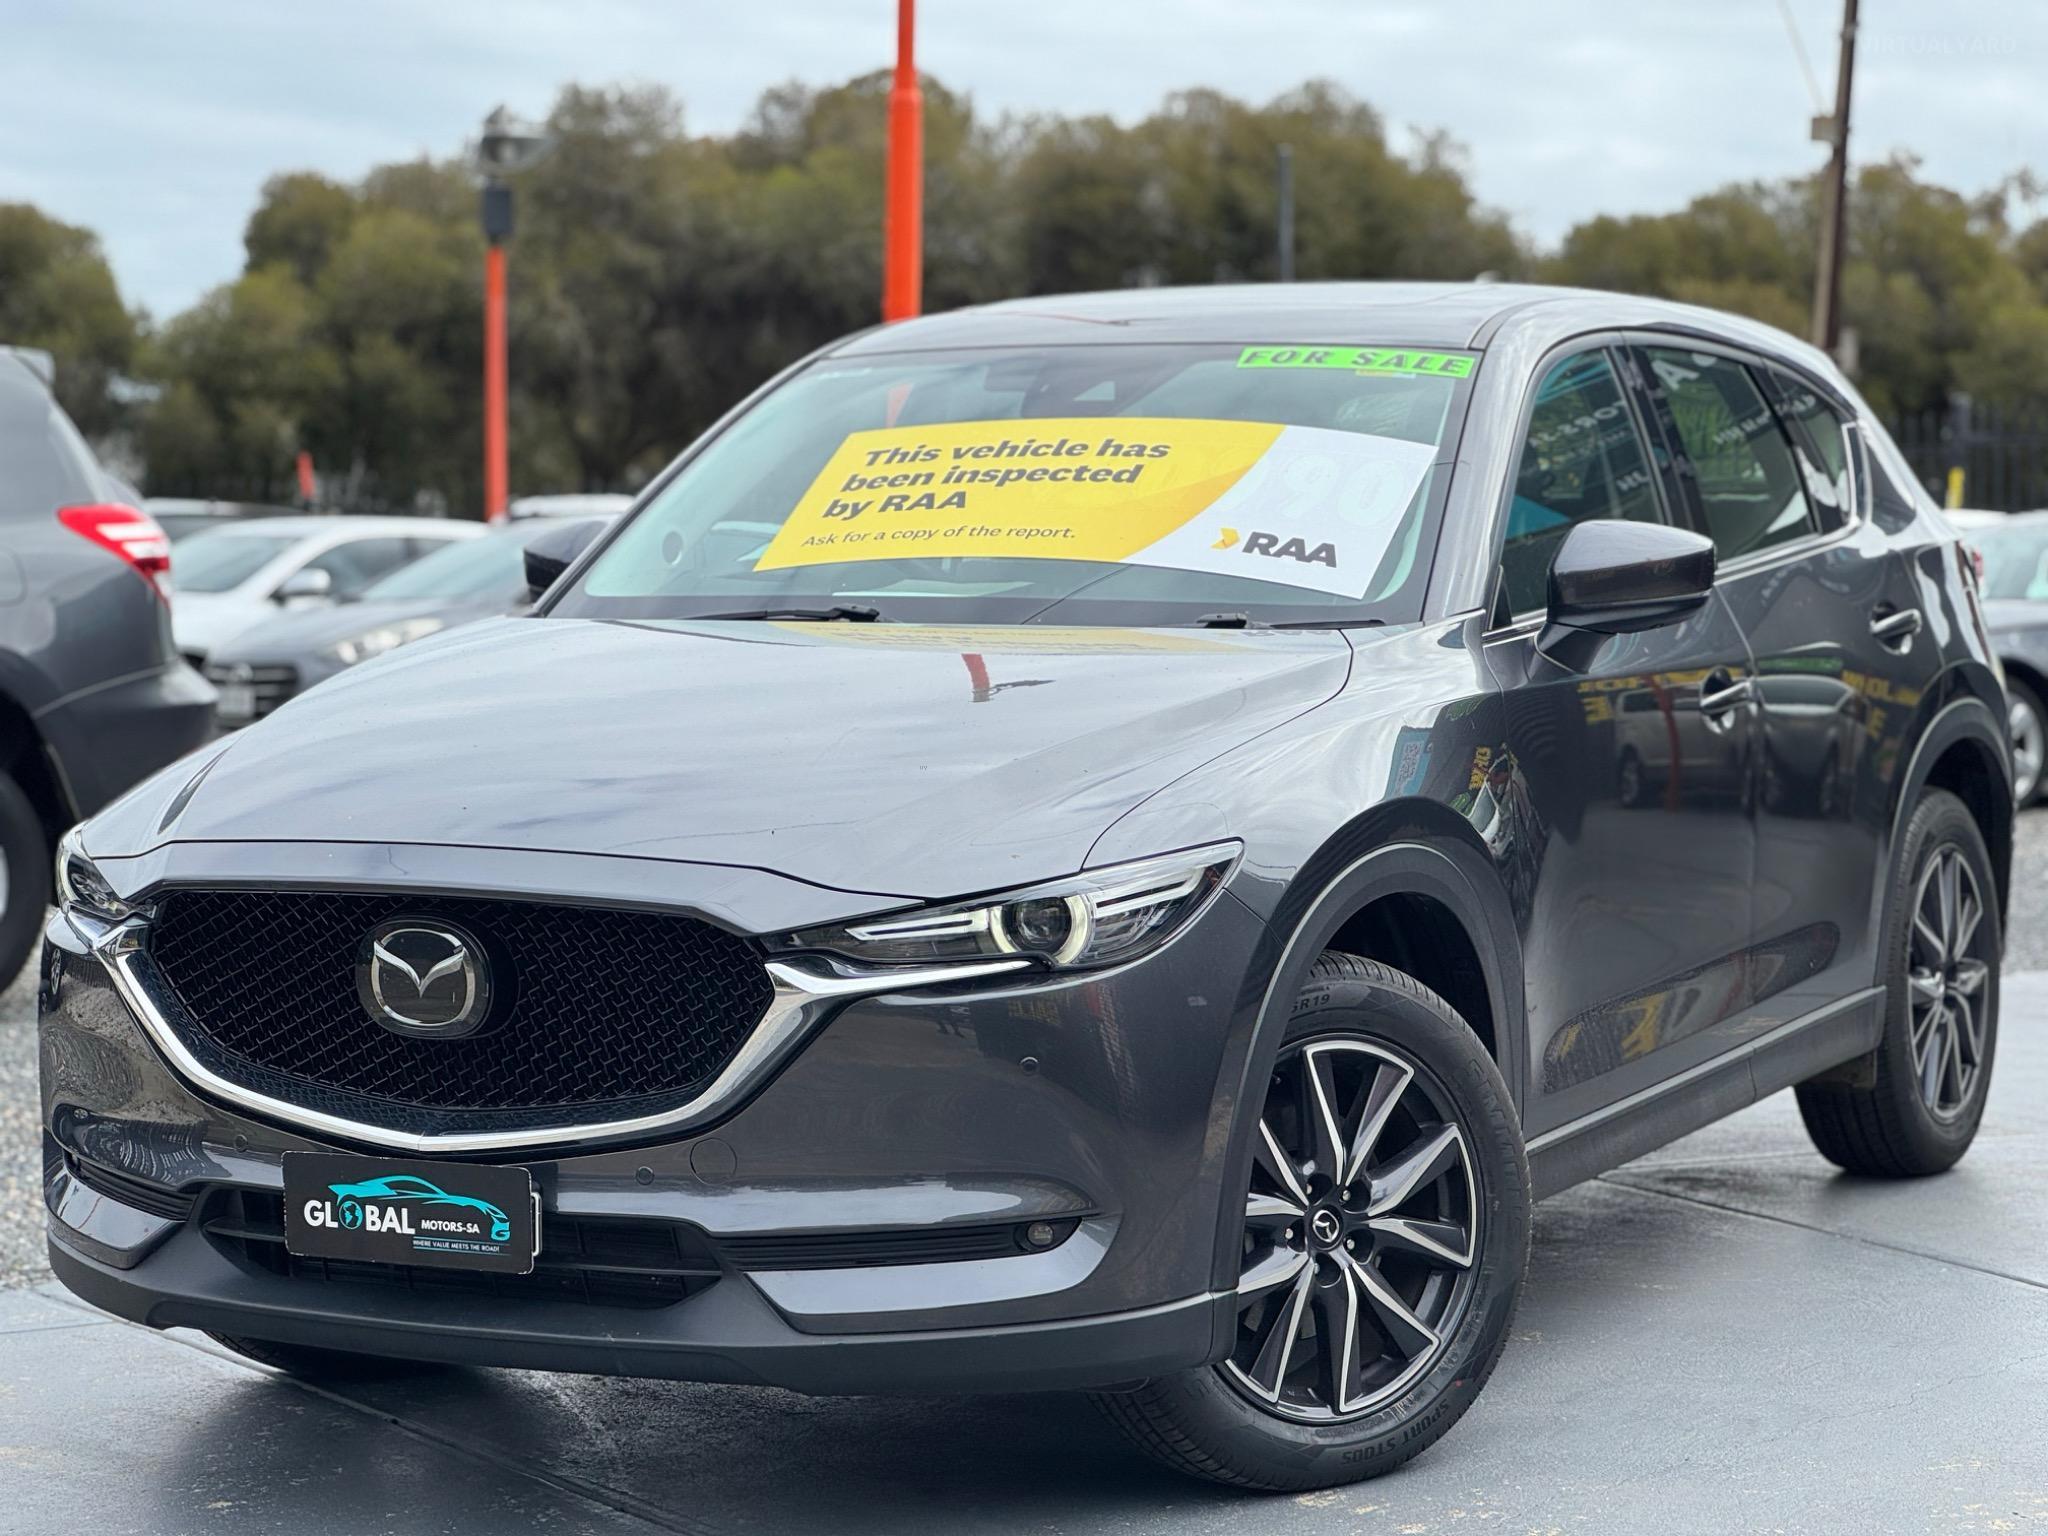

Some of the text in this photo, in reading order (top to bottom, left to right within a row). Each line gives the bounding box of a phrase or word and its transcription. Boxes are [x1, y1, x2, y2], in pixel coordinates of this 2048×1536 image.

[1243, 350, 1469, 374] FOR SALE
[865, 438, 1171, 467] This vehicle has
[840, 464, 1144, 493] been inspected
[822, 491, 967, 521] by RAA
[800, 525, 1075, 547] Ask for a copy of the report.
[1242, 531, 1337, 568] RAA
[303, 1199, 416, 1235] GLOBAL
[421, 1219, 480, 1234] MOTORS-SA
[432, 1241, 450, 1249] VALUE
[451, 1242, 469, 1250] MEETS
